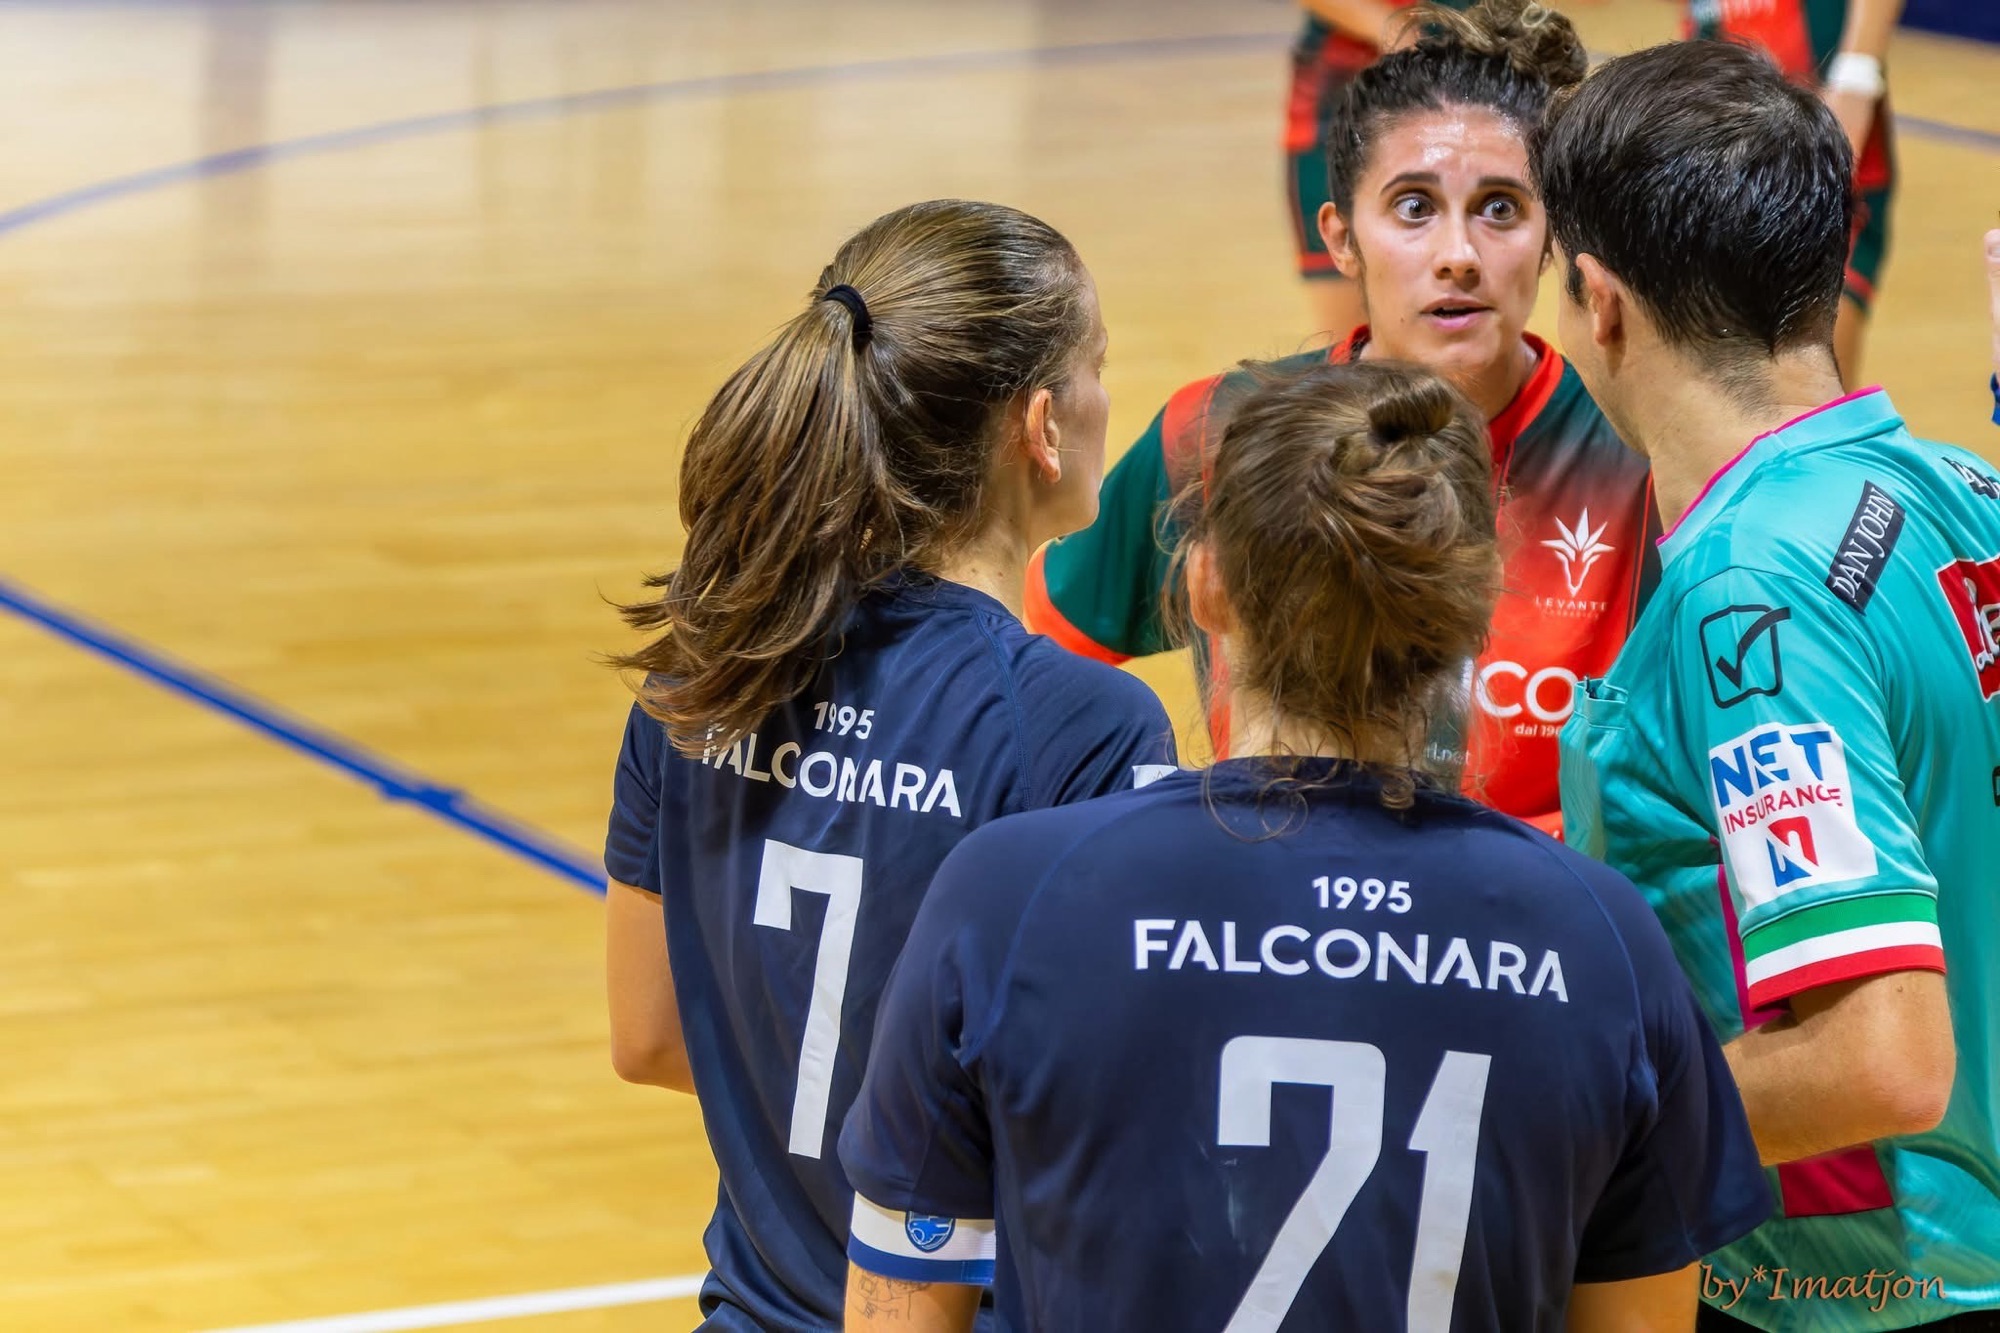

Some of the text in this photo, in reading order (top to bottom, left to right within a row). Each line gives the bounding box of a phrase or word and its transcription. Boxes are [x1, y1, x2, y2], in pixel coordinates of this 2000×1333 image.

[1832, 486, 1895, 602] DAN JOHN
[814, 701, 875, 740] 1995
[1710, 730, 1832, 808] NET
[1724, 784, 1844, 835] INSURANCE
[1312, 875, 1412, 913] 1995
[753, 838, 863, 1159] 7
[1134, 918, 1569, 1002] FALCONARA
[1216, 1035, 1492, 1333] 21
